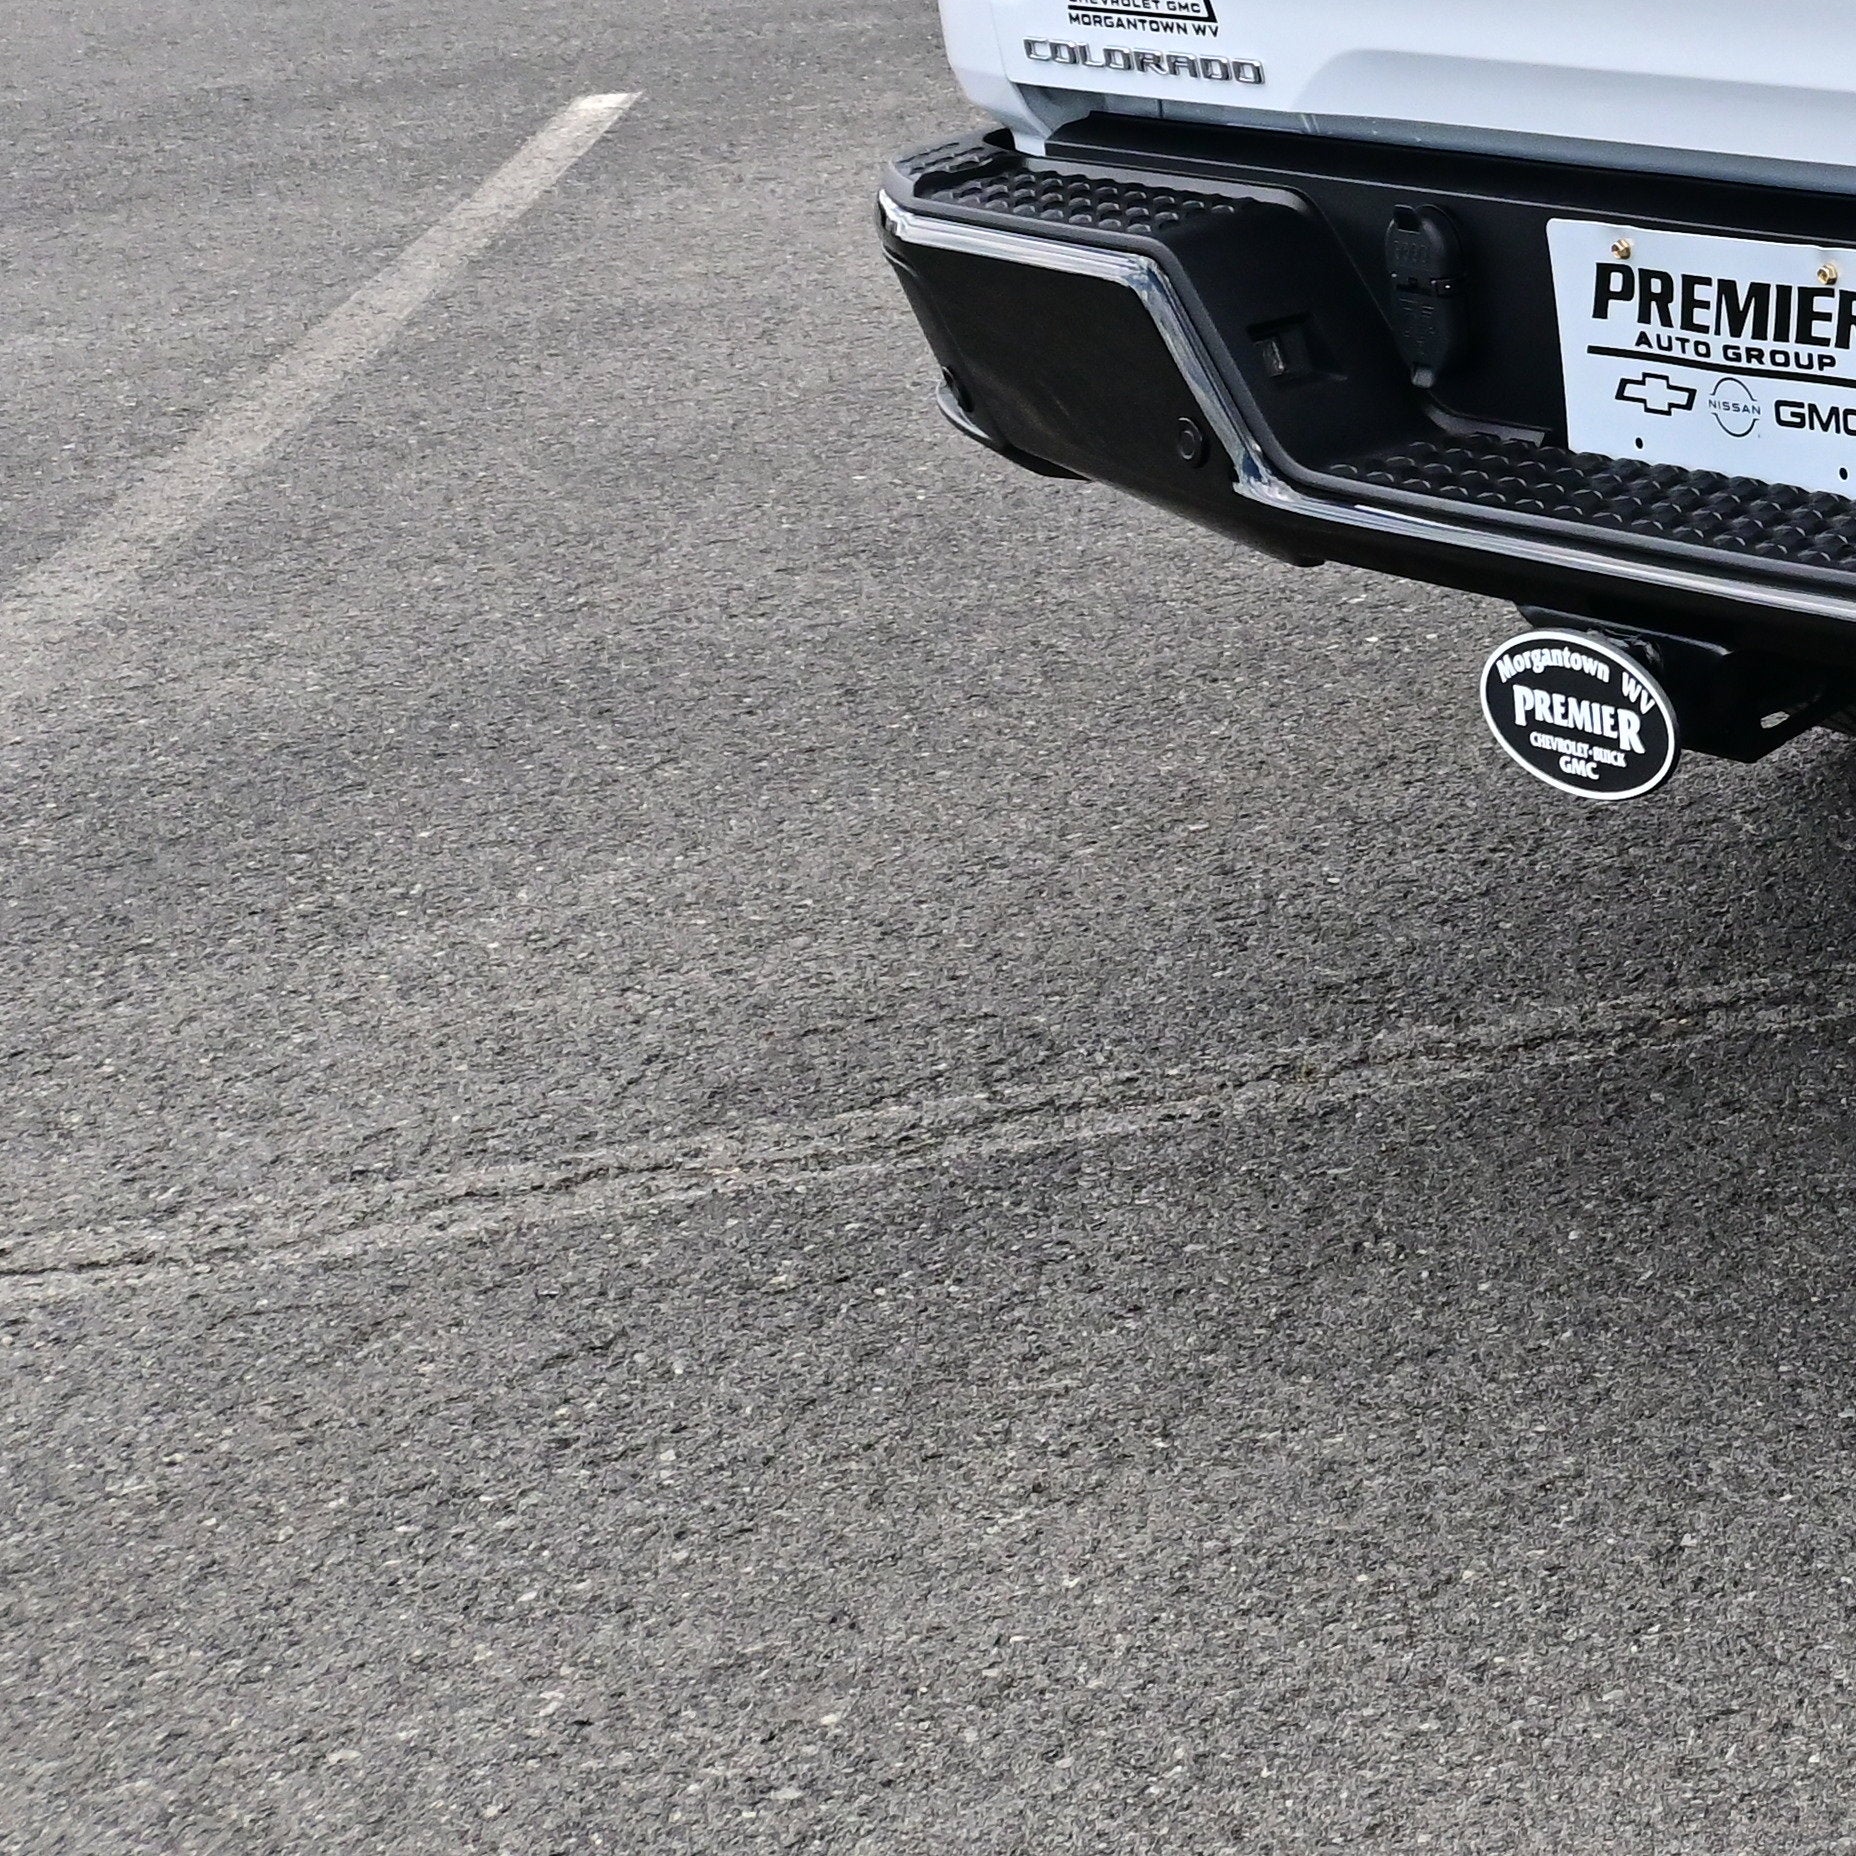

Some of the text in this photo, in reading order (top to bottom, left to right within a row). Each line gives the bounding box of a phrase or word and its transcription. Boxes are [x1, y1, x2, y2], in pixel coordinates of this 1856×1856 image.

[1166, 0, 1202, 14] GMC
[1067, 12, 1219, 38] MORGANTOWN WV
[1023, 36, 1266, 85] COLORADO
[1634, 330, 1837, 372] AUTO GROUP
[1708, 398, 1761, 416] NISSAN
[1495, 646, 1656, 715] Morgantown WV
[1512, 684, 1646, 754] PREMIER
[1558, 755, 1600, 780] GMC
